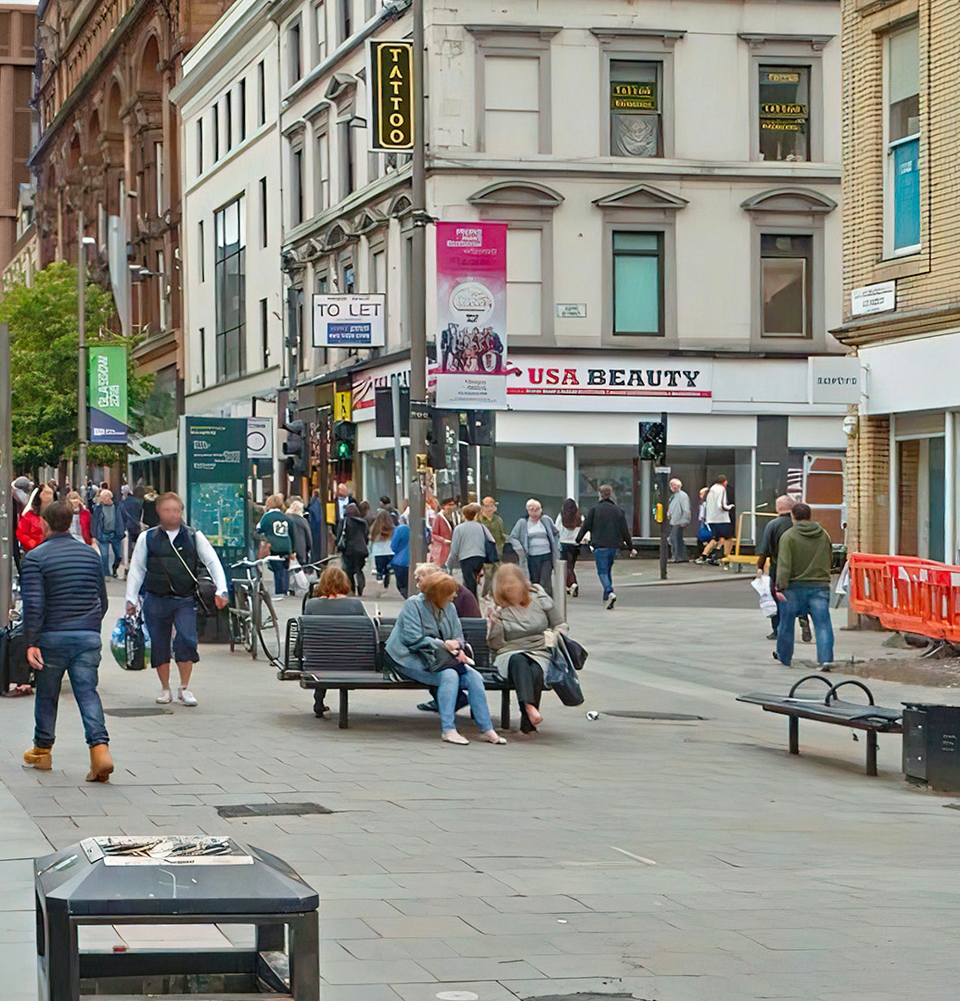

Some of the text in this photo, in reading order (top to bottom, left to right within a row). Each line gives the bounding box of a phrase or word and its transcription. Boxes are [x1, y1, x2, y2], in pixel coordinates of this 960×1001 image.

[388, 48, 405, 144] TATTOO
[317, 303, 382, 317] TO LET
[527, 367, 701, 388] USA BEAUTY
